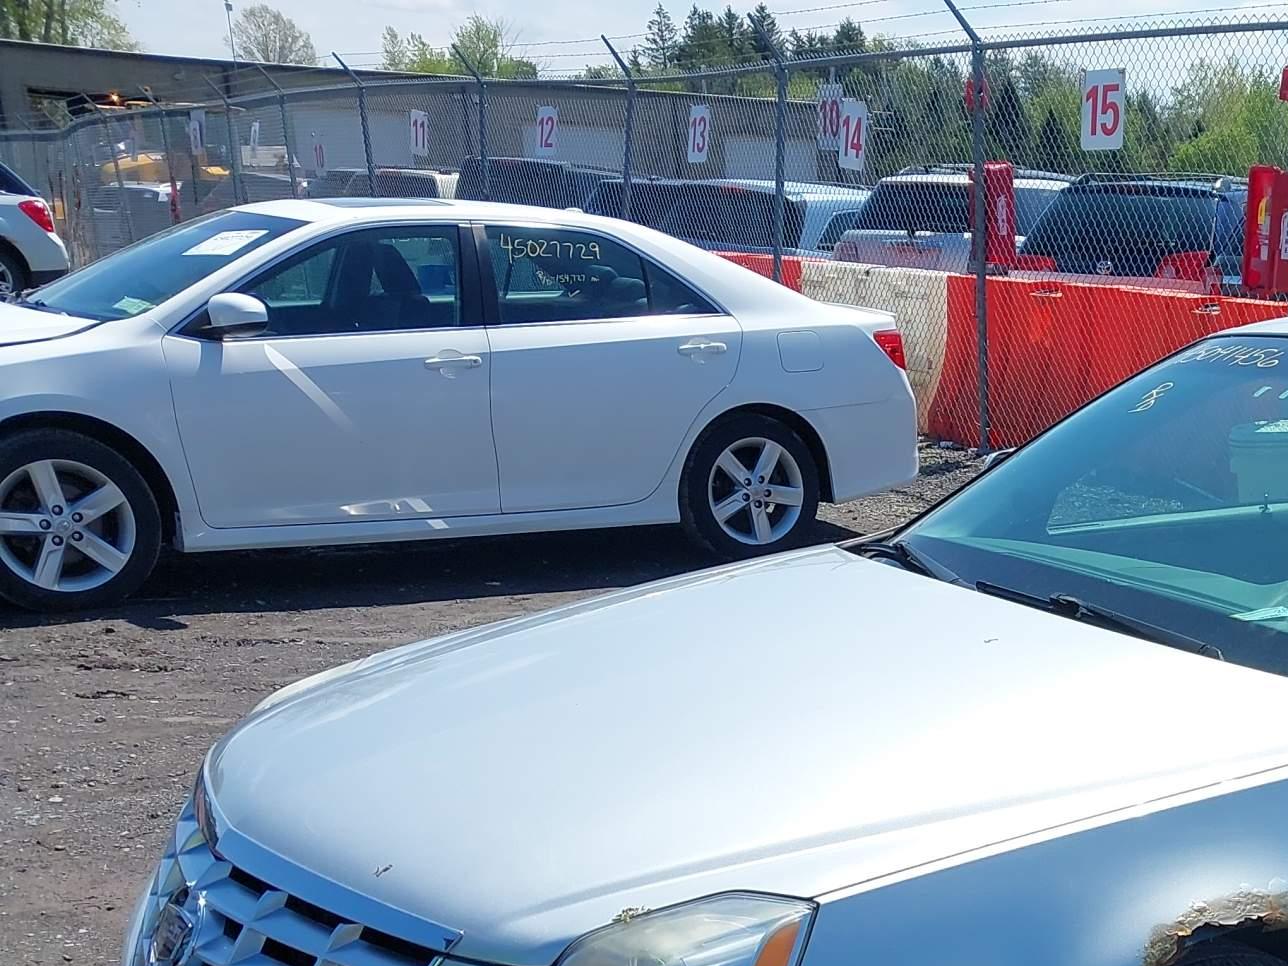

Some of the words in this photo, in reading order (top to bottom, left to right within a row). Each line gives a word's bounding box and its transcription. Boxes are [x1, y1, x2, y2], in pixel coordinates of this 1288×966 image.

[819, 99, 841, 139] 10
[1085, 83, 1120, 137] 15
[412, 118, 426, 149] 11
[537, 115, 555, 149] 12
[690, 115, 708, 154] 13
[841, 114, 863, 160] 14
[314, 143, 325, 169] 10
[500, 233, 601, 264] 45027729
